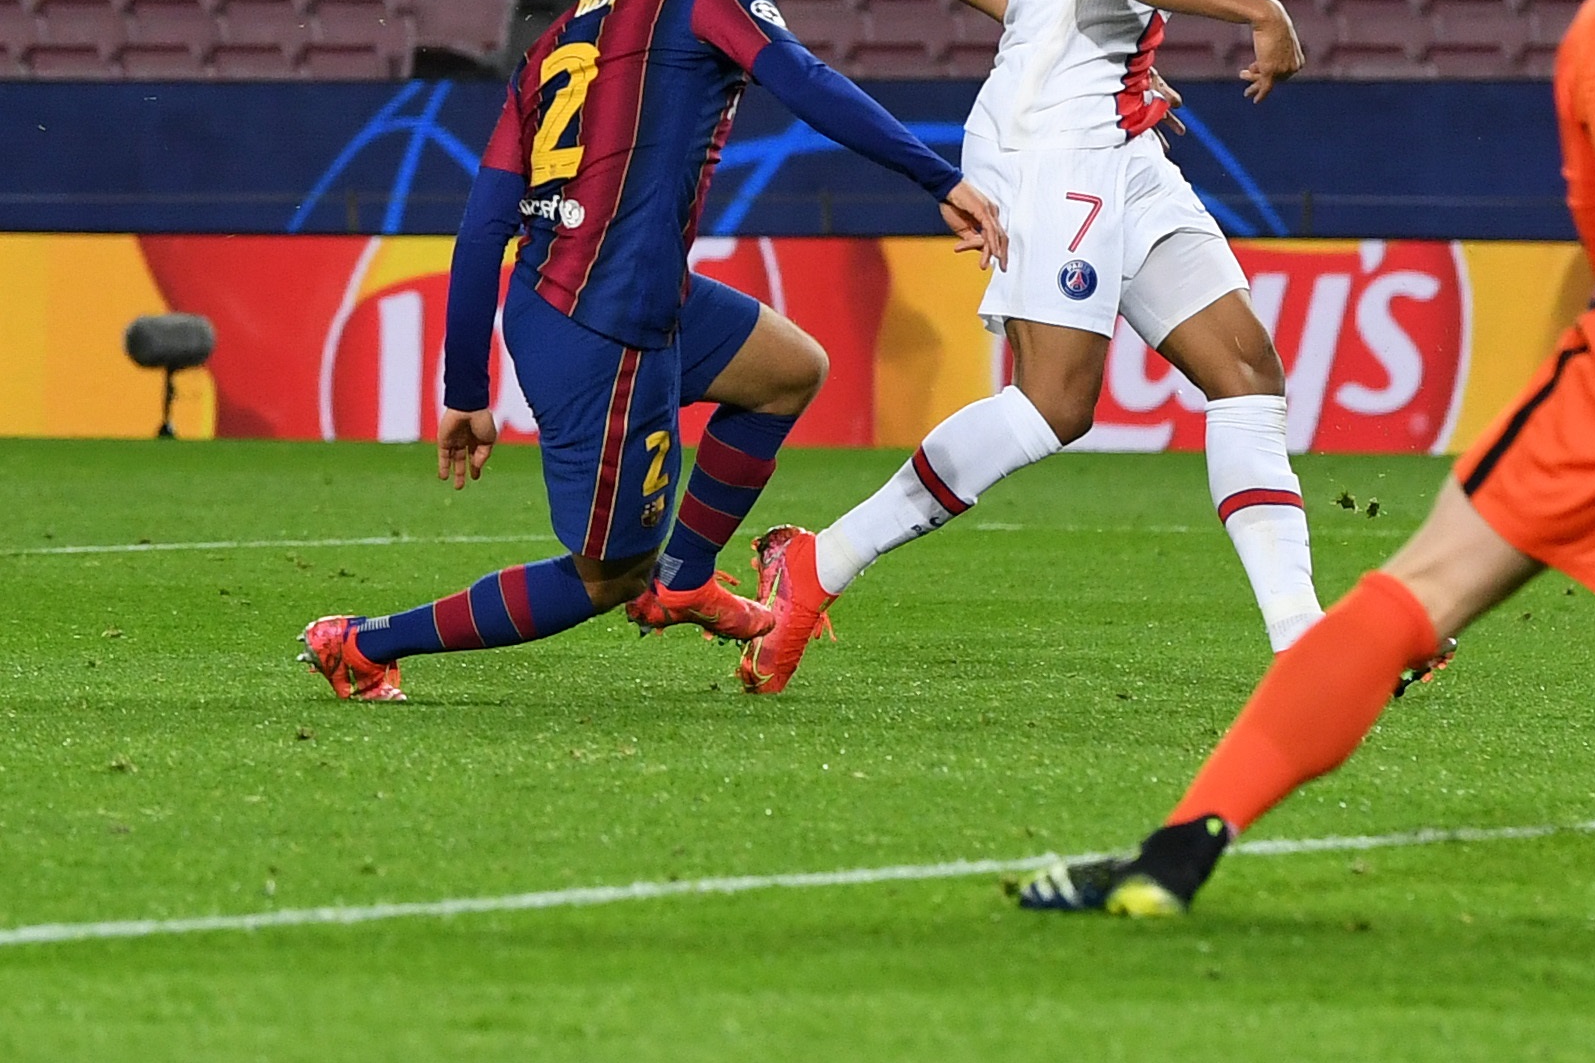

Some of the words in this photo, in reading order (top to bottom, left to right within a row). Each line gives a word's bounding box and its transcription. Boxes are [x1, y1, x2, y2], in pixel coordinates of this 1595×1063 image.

[530, 42, 601, 187] 2
[1065, 191, 1103, 253] 7
[643, 430, 671, 497] 2
